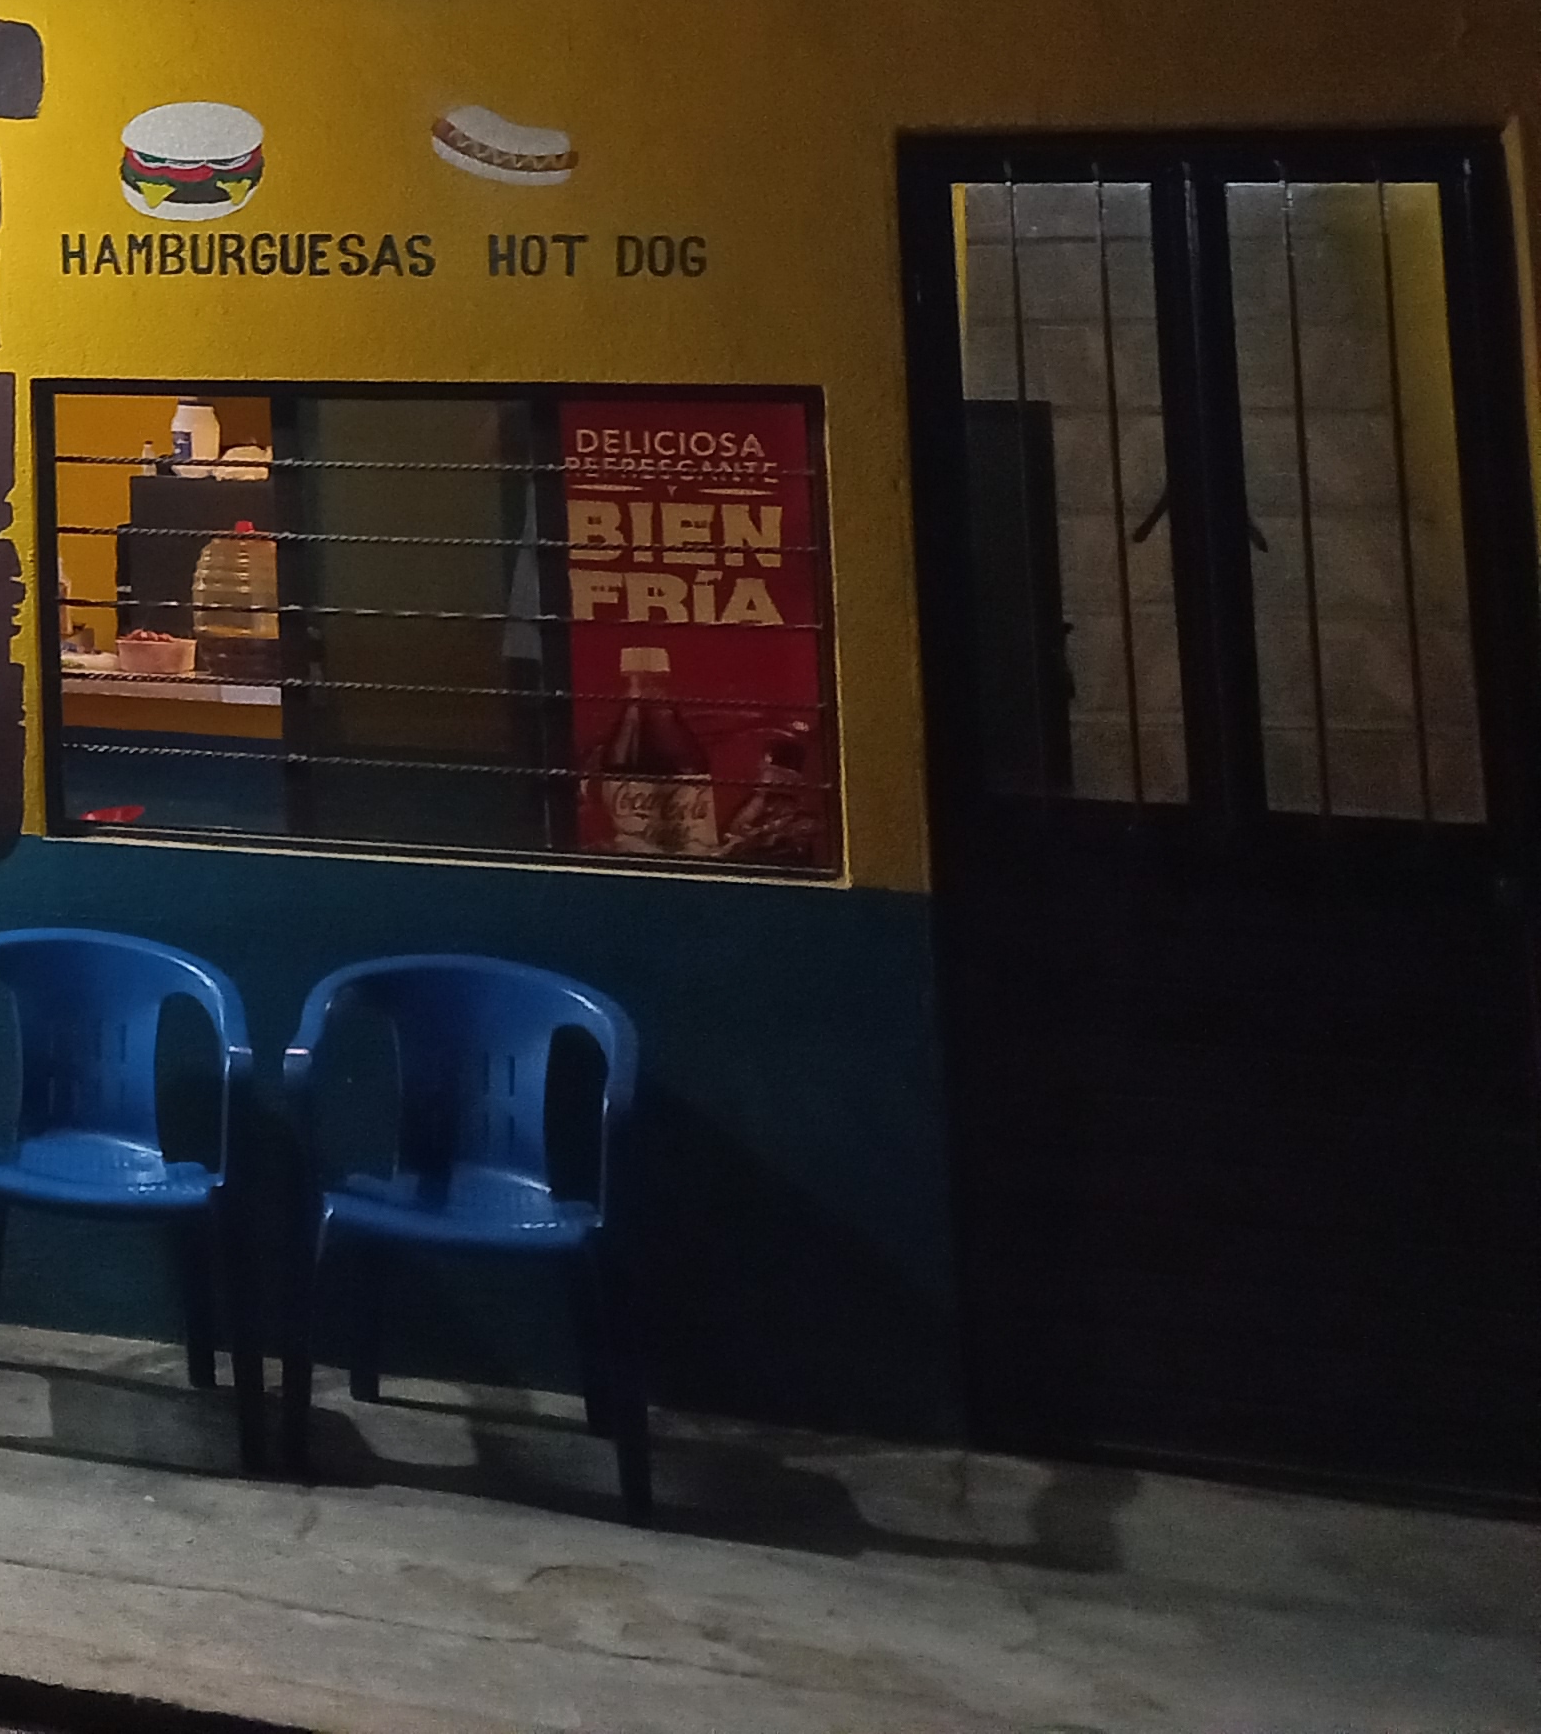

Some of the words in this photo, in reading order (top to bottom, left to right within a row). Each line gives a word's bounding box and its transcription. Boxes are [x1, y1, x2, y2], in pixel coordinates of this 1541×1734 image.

[60, 232, 437, 279] HAMBURGUESAS
[487, 233, 591, 279] HOT
[619, 234, 709, 279] DOG
[575, 428, 766, 458] DELICIOSA
[567, 499, 783, 568] BIEN
[568, 568, 784, 625] FRÍA
